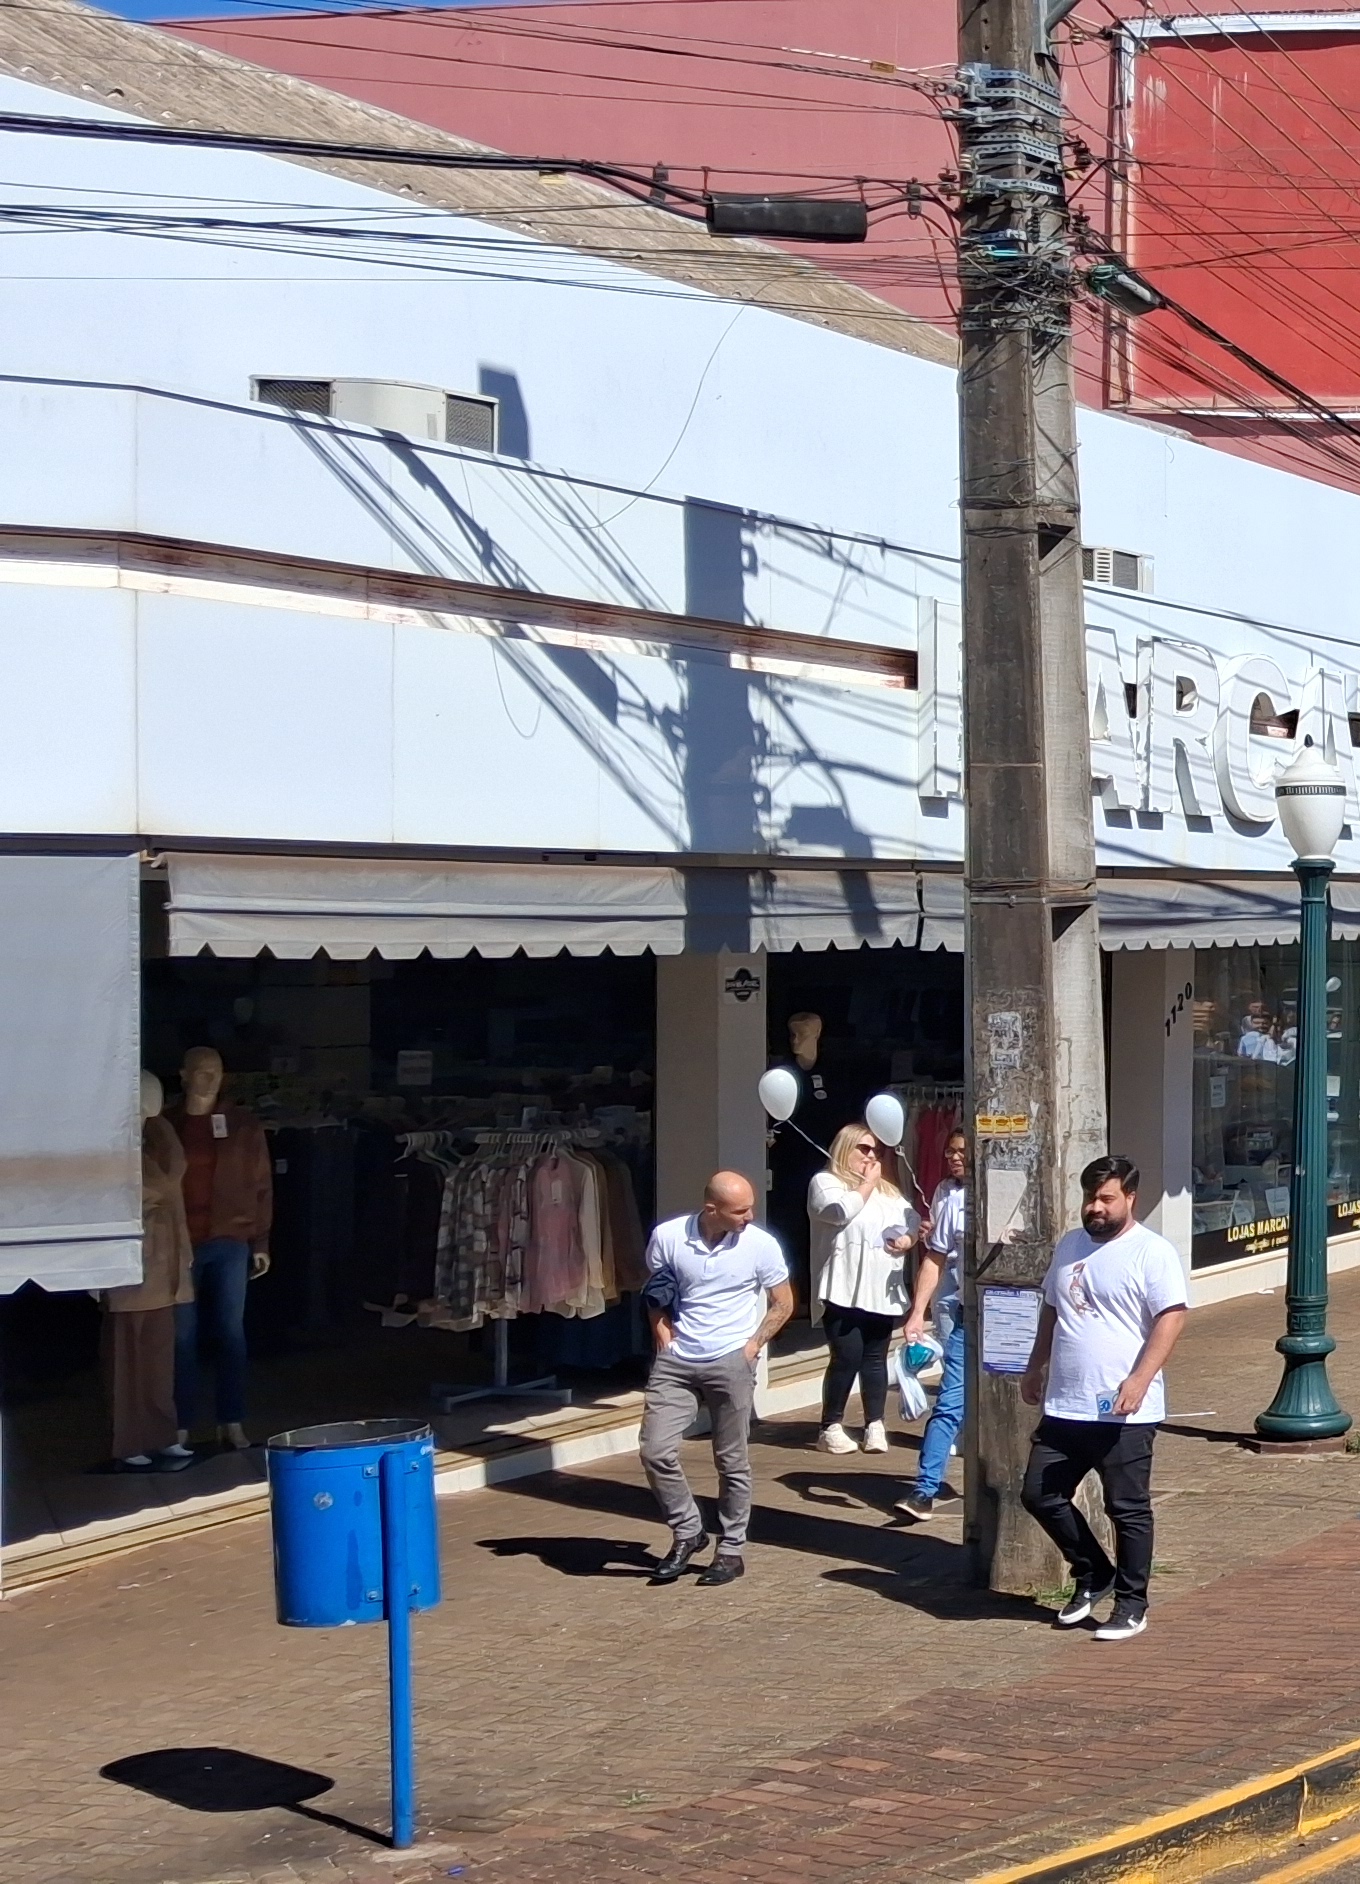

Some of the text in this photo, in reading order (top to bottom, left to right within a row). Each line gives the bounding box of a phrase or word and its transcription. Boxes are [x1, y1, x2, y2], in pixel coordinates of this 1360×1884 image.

[1165, 982, 1193, 1037] 1120
[1337, 1199, 1360, 1218] LOJAS
[1227, 1215, 1290, 1242] LOJAS MARCAT
